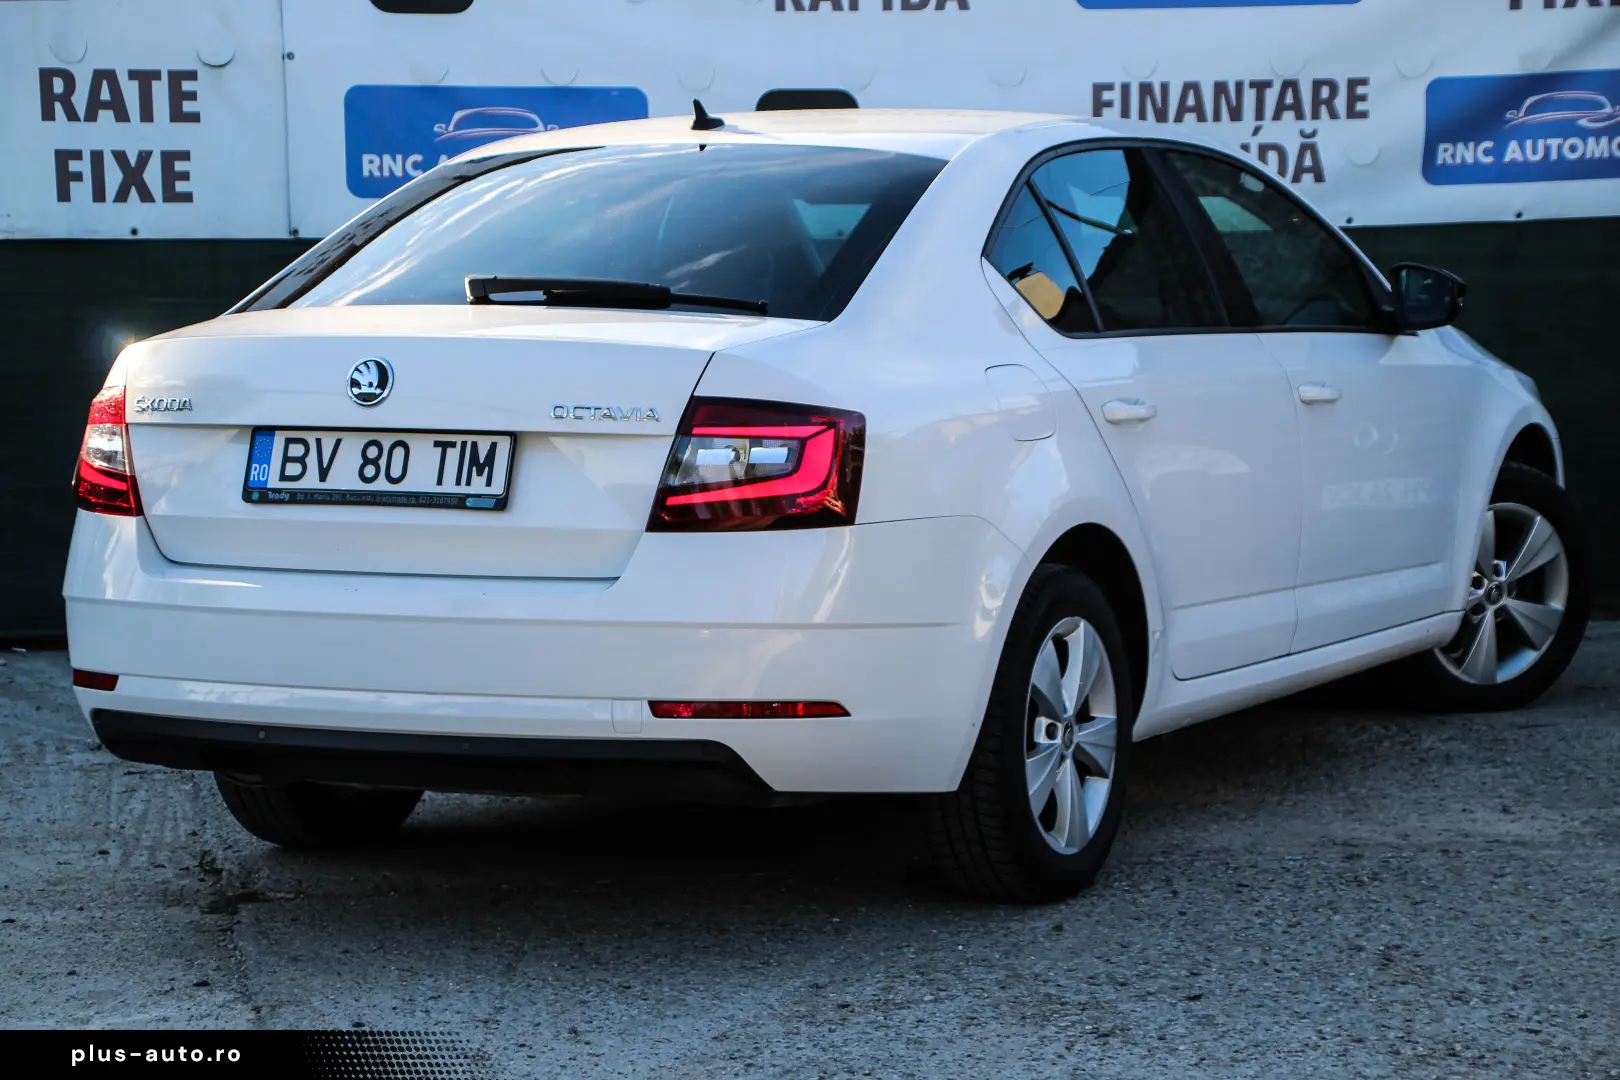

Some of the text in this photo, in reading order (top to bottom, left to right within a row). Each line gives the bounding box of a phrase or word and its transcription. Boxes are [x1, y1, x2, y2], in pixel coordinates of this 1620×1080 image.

[38, 67, 201, 123] RATE
[361, 153, 424, 178] RNC
[1436, 138, 1494, 166] RNC
[55, 149, 194, 203] FIXE
[550, 404, 661, 422] OCTAVIA
[250, 463, 268, 481] RO
[278, 437, 498, 487] BV 80 TIM
